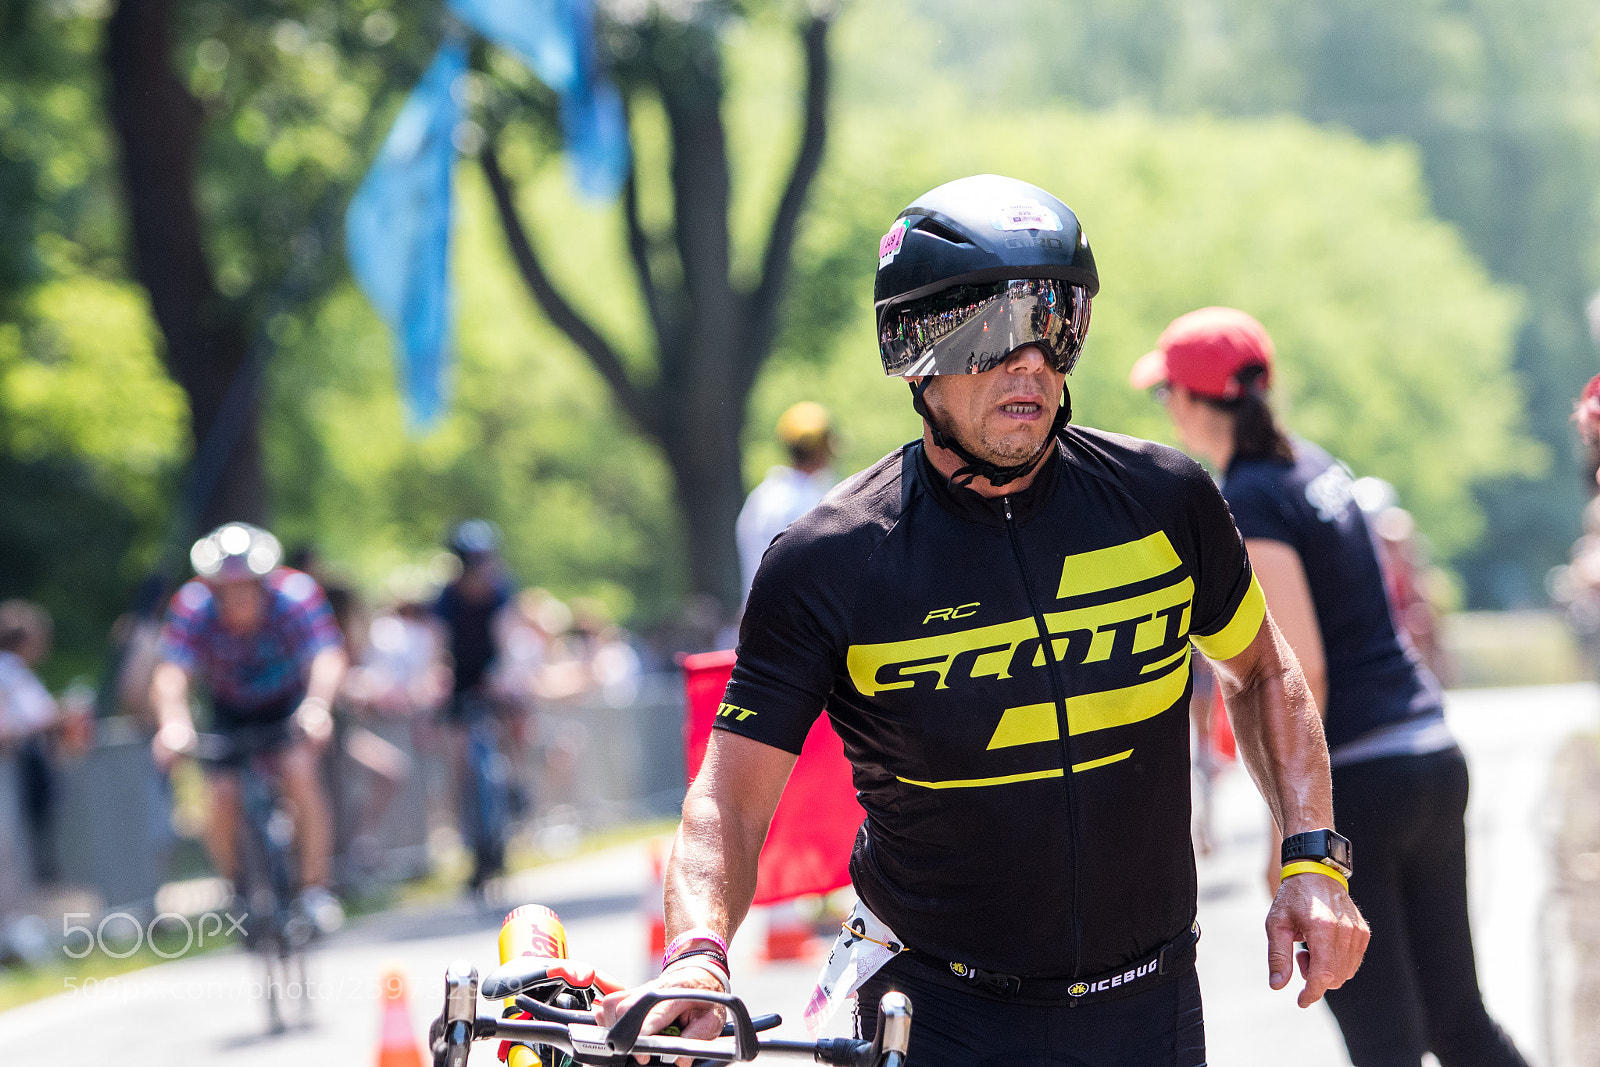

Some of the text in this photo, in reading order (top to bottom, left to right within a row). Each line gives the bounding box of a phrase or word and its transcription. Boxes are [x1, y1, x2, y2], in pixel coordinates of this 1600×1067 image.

[923, 602, 980, 624] RC
[874, 599, 1191, 693] SCOTT
[1090, 959, 1157, 993] ICEBUG
